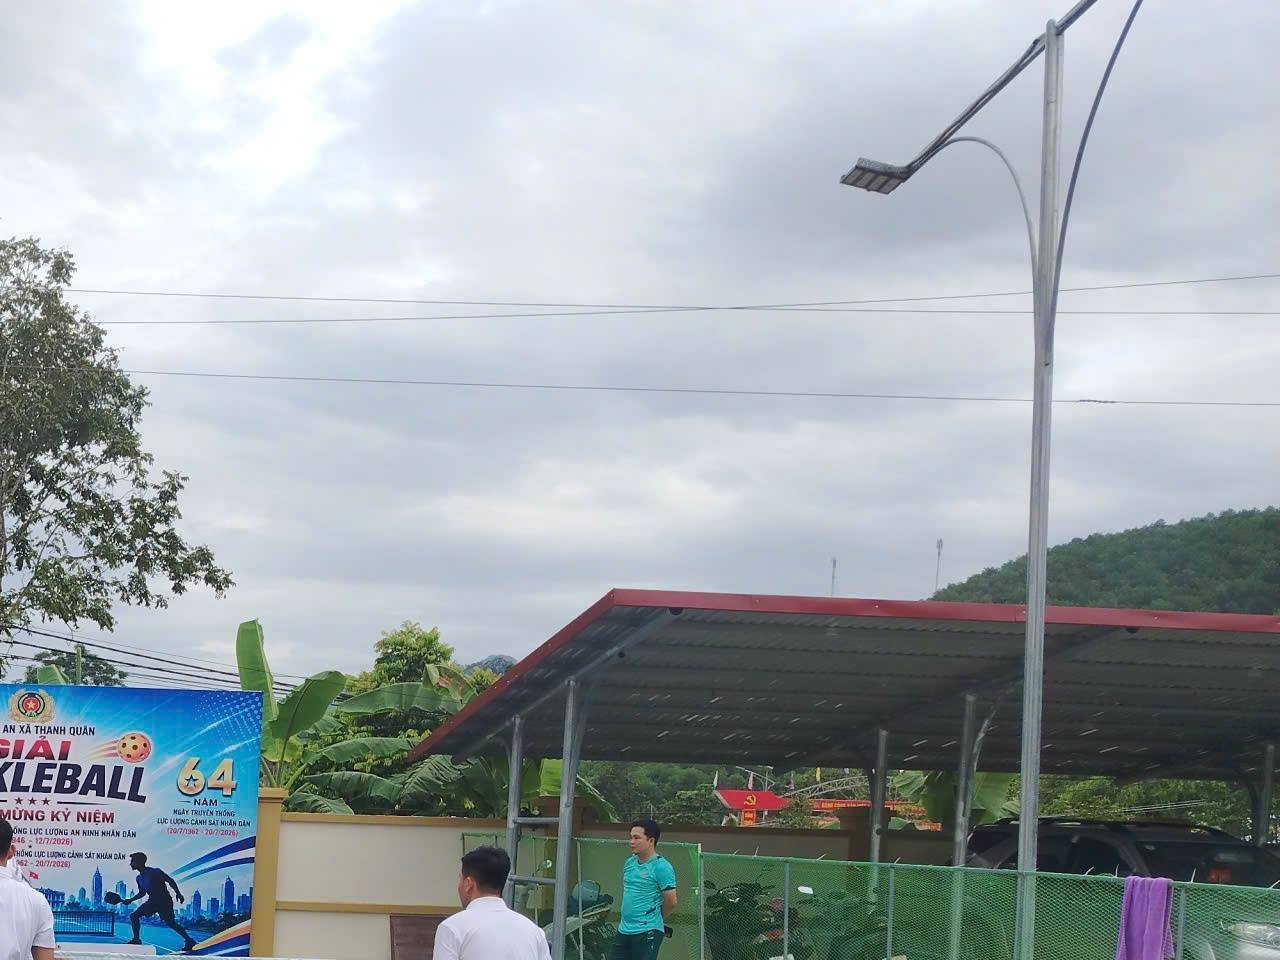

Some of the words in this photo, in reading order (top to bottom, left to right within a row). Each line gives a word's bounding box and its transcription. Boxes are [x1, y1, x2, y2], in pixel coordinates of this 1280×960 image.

[2, 724, 16, 734] AN
[19, 724, 32, 735] XÃ
[34, 726, 66, 735] THANH
[69, 726, 96, 737] QUÂN
[176, 757, 237, 797] 64
[0, 807, 45, 821] MỪNG
[51, 808, 71, 822] KỶ
[76, 810, 115, 826] NIỆM
[29, 828, 43, 836] LỰC
[45, 828, 68, 837] LƯỢNG
[101, 830, 121, 838] NHÂN
[122, 830, 137, 838] DÂN
[35, 838, 73, 846] 12/7/2026)
[16, 850, 33, 858] HỐNG
[67, 850, 83, 859] CẢNH
[84, 851, 95, 859] SÁT
[96, 852, 112, 860] NHÂN
[114, 852, 126, 860] DÂN
[35, 860, 71, 868] 20/7/2026)
